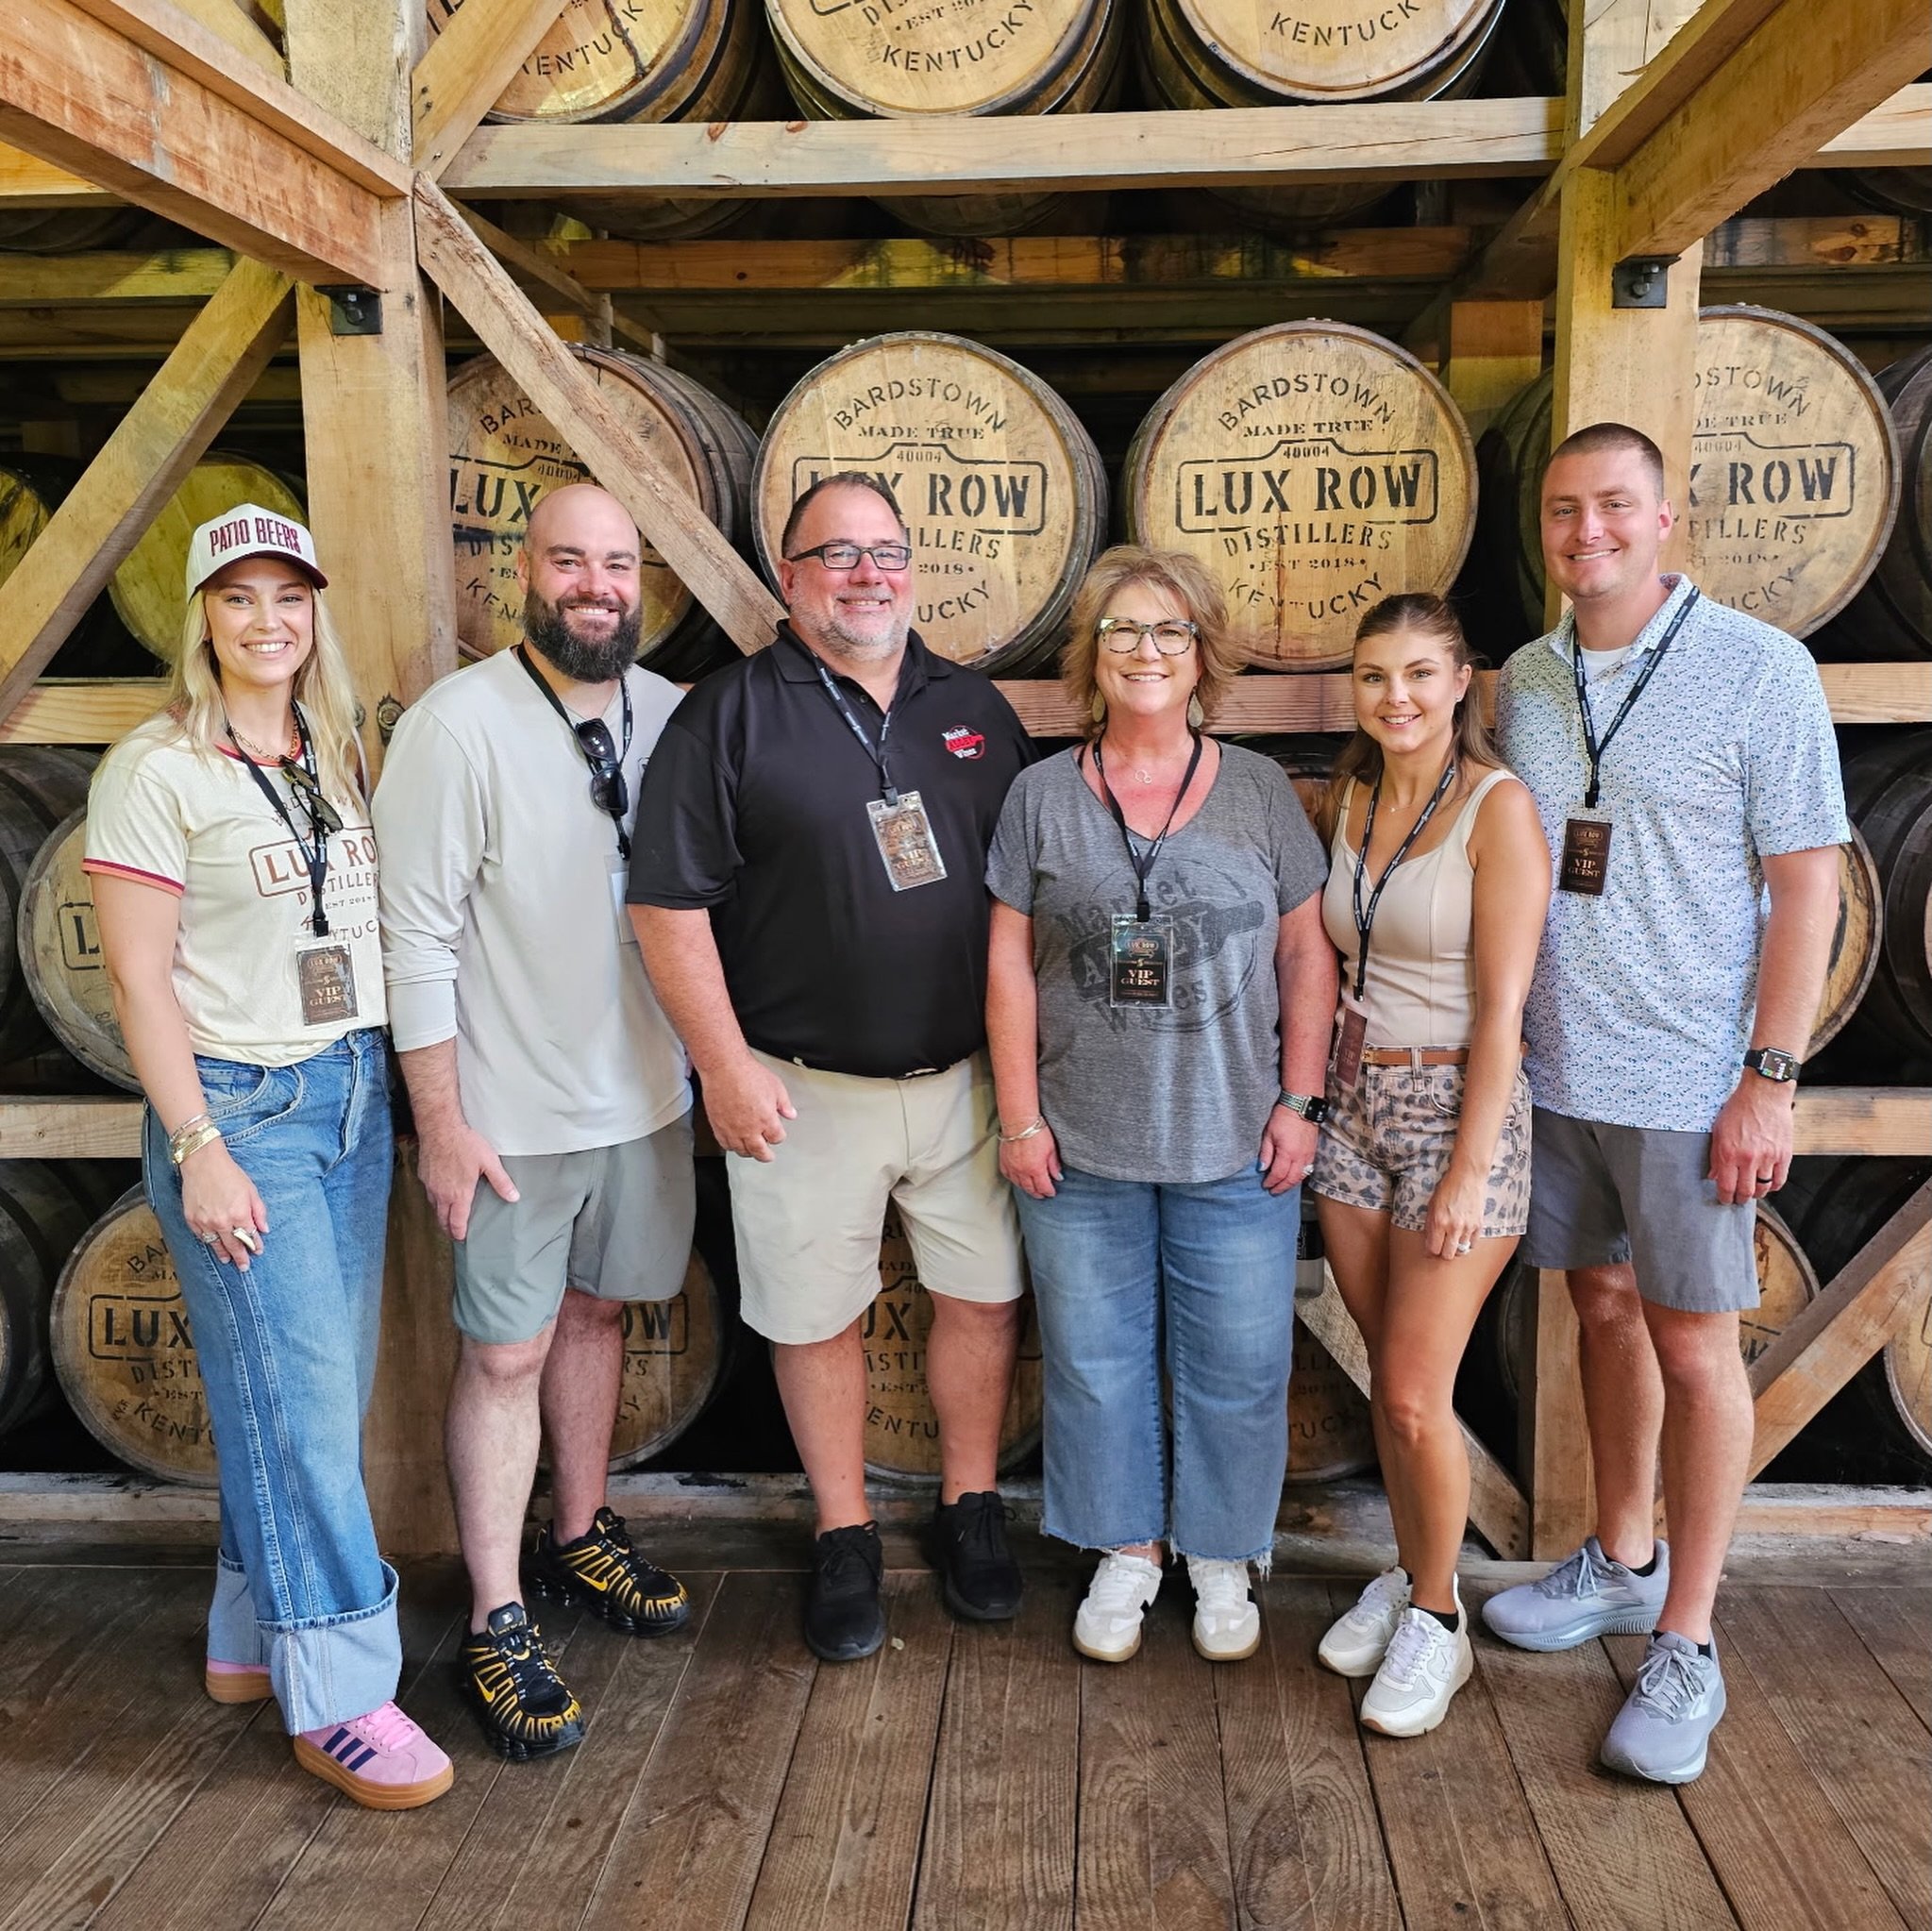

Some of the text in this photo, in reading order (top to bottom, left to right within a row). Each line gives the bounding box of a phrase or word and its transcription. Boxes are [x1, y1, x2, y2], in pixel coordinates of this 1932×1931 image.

[833, 378, 1006, 433] BARDSTOWN
[1218, 373, 1396, 431] BARDSTOWN
[1695, 366, 1810, 416] STOWN
[858, 427, 984, 440] MADE TRUE
[1244, 420, 1373, 437] MADE TRUE
[1725, 413, 1787, 428] TRUE
[502, 432, 563, 455] MADE
[897, 450, 942, 463] 40004
[1284, 445, 1329, 460] 40004
[450, 469, 542, 524] LUX
[928, 473, 1030, 518] ROW
[1194, 463, 1421, 516] LUX ROW
[1728, 457, 1838, 505] ROW
[210, 517, 302, 557] PATIO BEERS
[1223, 522, 1392, 557] DISTILLERS
[1688, 518, 1806, 545] TILLERS
[918, 563, 966, 575] 2018
[1309, 558, 1357, 570] 2018
[916, 579, 990, 623] UCKY
[341, 835, 378, 867] RO
[1574, 859, 1596, 868] VIP
[1120, 978, 1160, 986] GUEST
[1128, 969, 1153, 979] VIP
[315, 986, 341, 997] VIP
[105, 1308, 194, 1349] LUX
[623, 1302, 672, 1340] OW
[866, 1405, 939, 1439] ENTU
